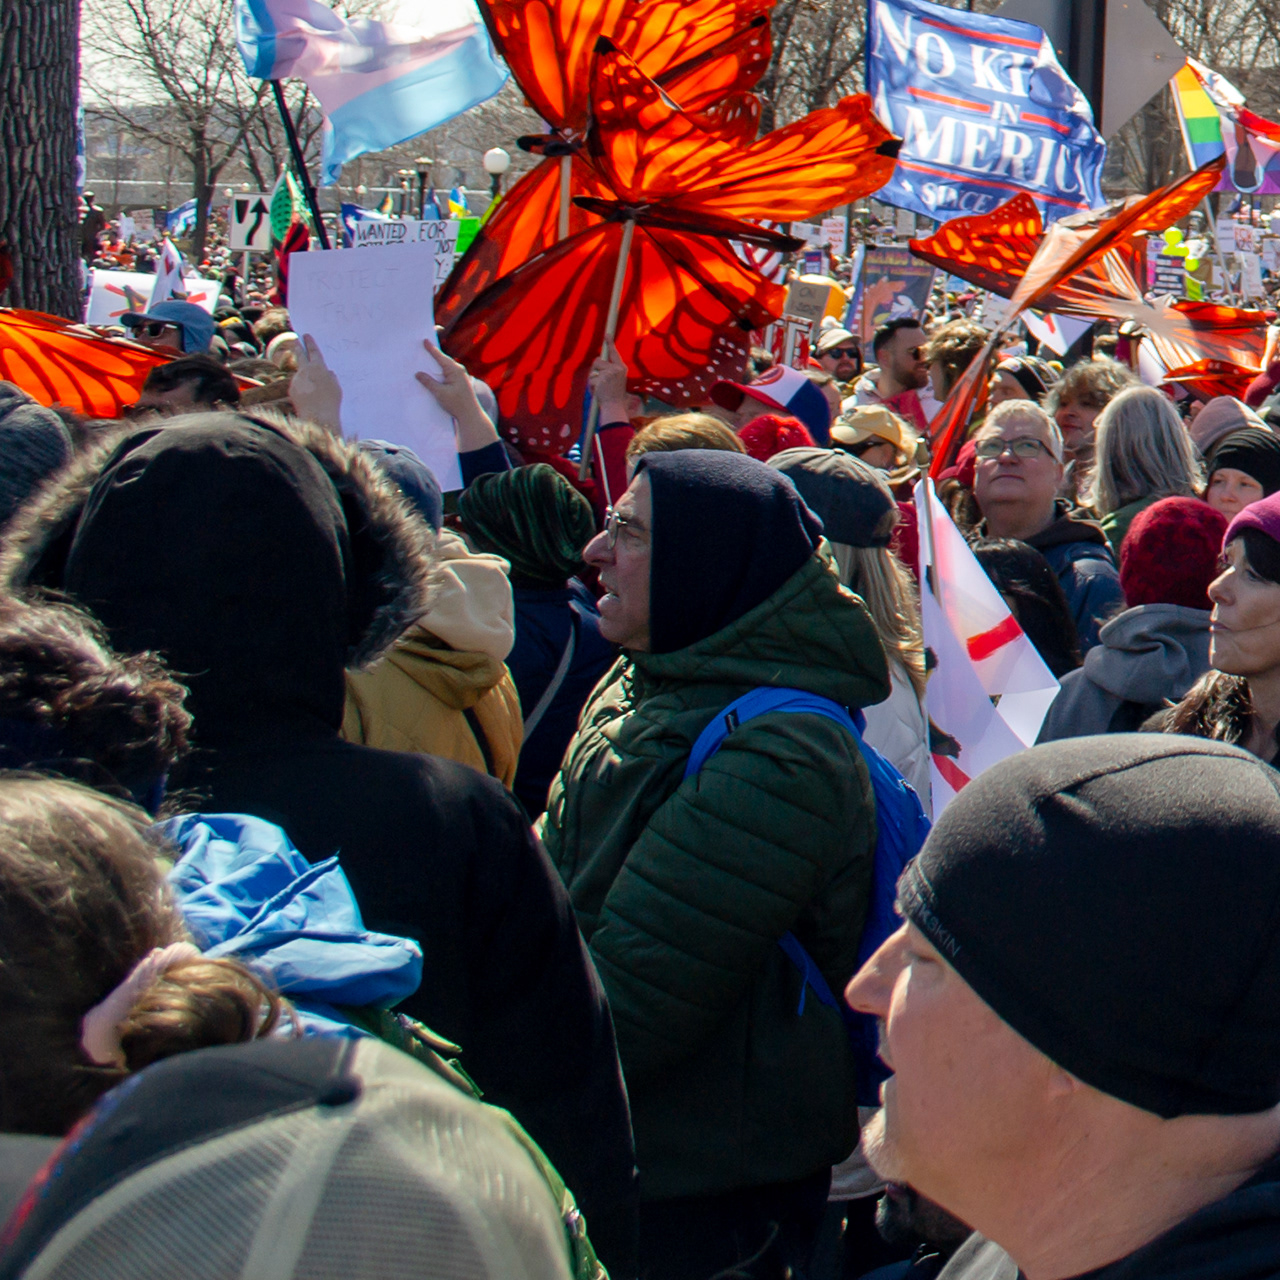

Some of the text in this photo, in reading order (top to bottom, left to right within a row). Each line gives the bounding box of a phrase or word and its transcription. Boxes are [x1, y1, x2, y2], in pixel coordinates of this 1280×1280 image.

[872, 0, 956, 78] NO
[991, 100, 1021, 126] IN
[356, 222, 448, 240] WANTED FOR
